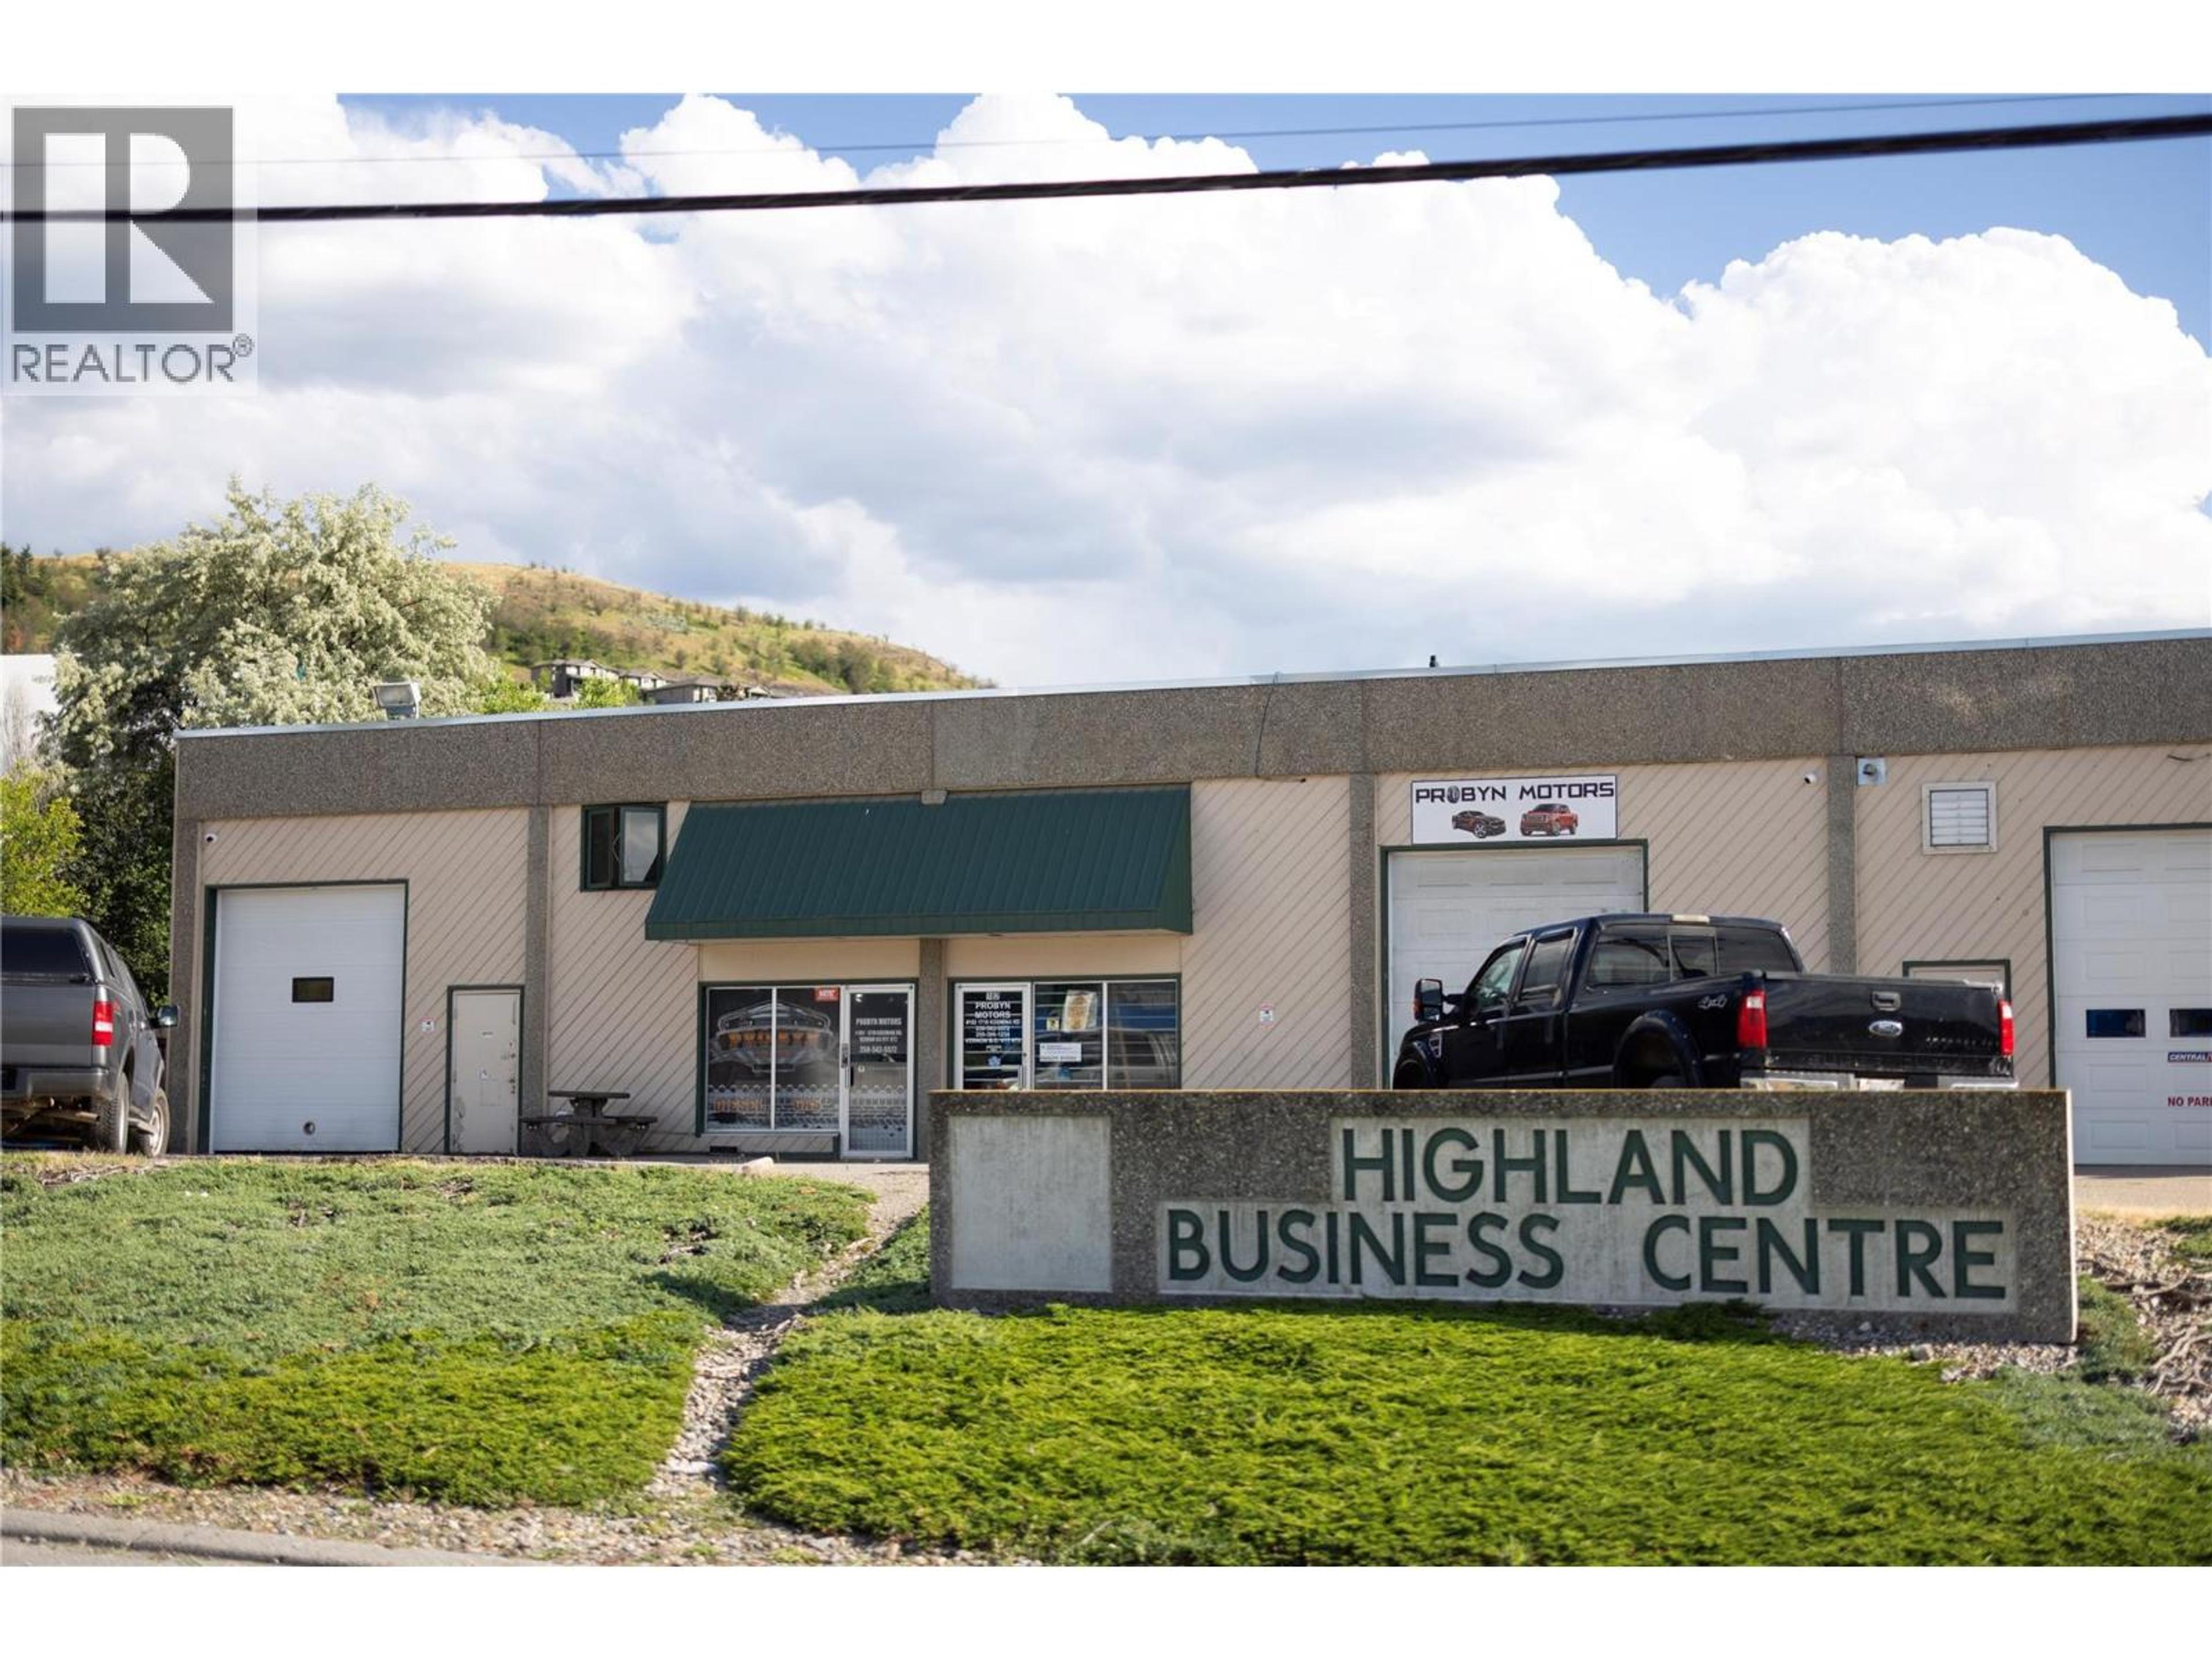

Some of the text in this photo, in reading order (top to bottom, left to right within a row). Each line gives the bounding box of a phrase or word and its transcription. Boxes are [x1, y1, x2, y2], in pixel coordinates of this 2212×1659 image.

[1519, 782, 1614, 800] MOTORS
[2168, 1096, 2184, 1107] NO
[1343, 1127, 1799, 1207] HIGHLAND
[1167, 1209, 2006, 1299] BUSINESS CENTRE
